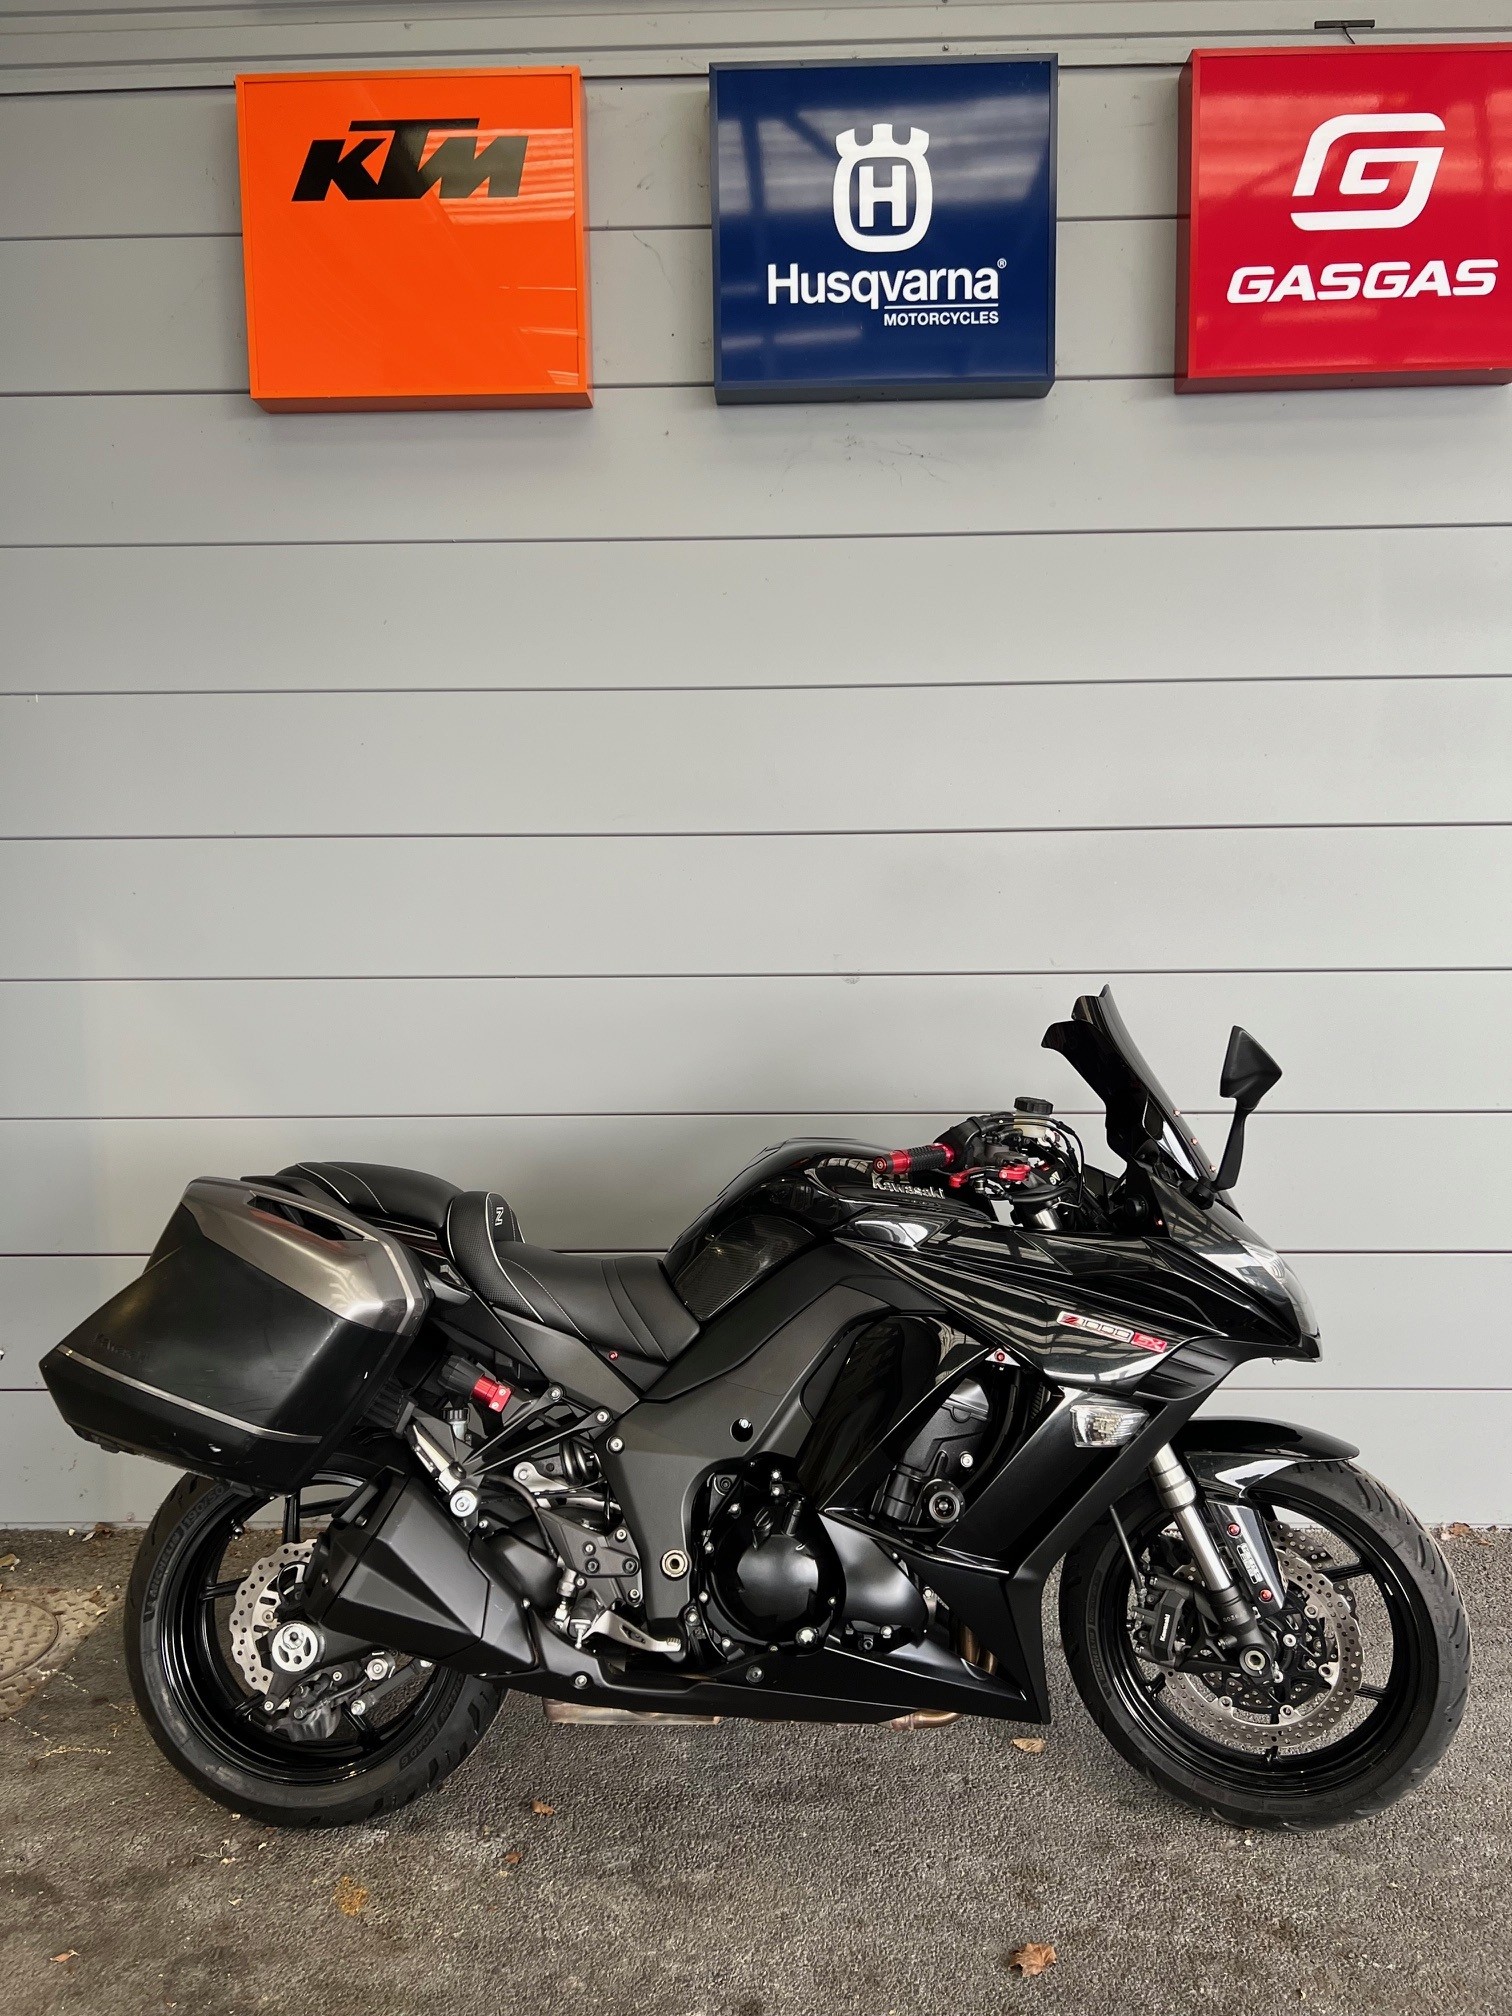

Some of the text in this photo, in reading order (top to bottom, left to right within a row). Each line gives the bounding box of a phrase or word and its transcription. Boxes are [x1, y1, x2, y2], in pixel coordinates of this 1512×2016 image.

[292, 118, 528, 201] KTM
[1226, 259, 1499, 303] GASGAS
[883, 310, 999, 326] MOTORCYCLES
